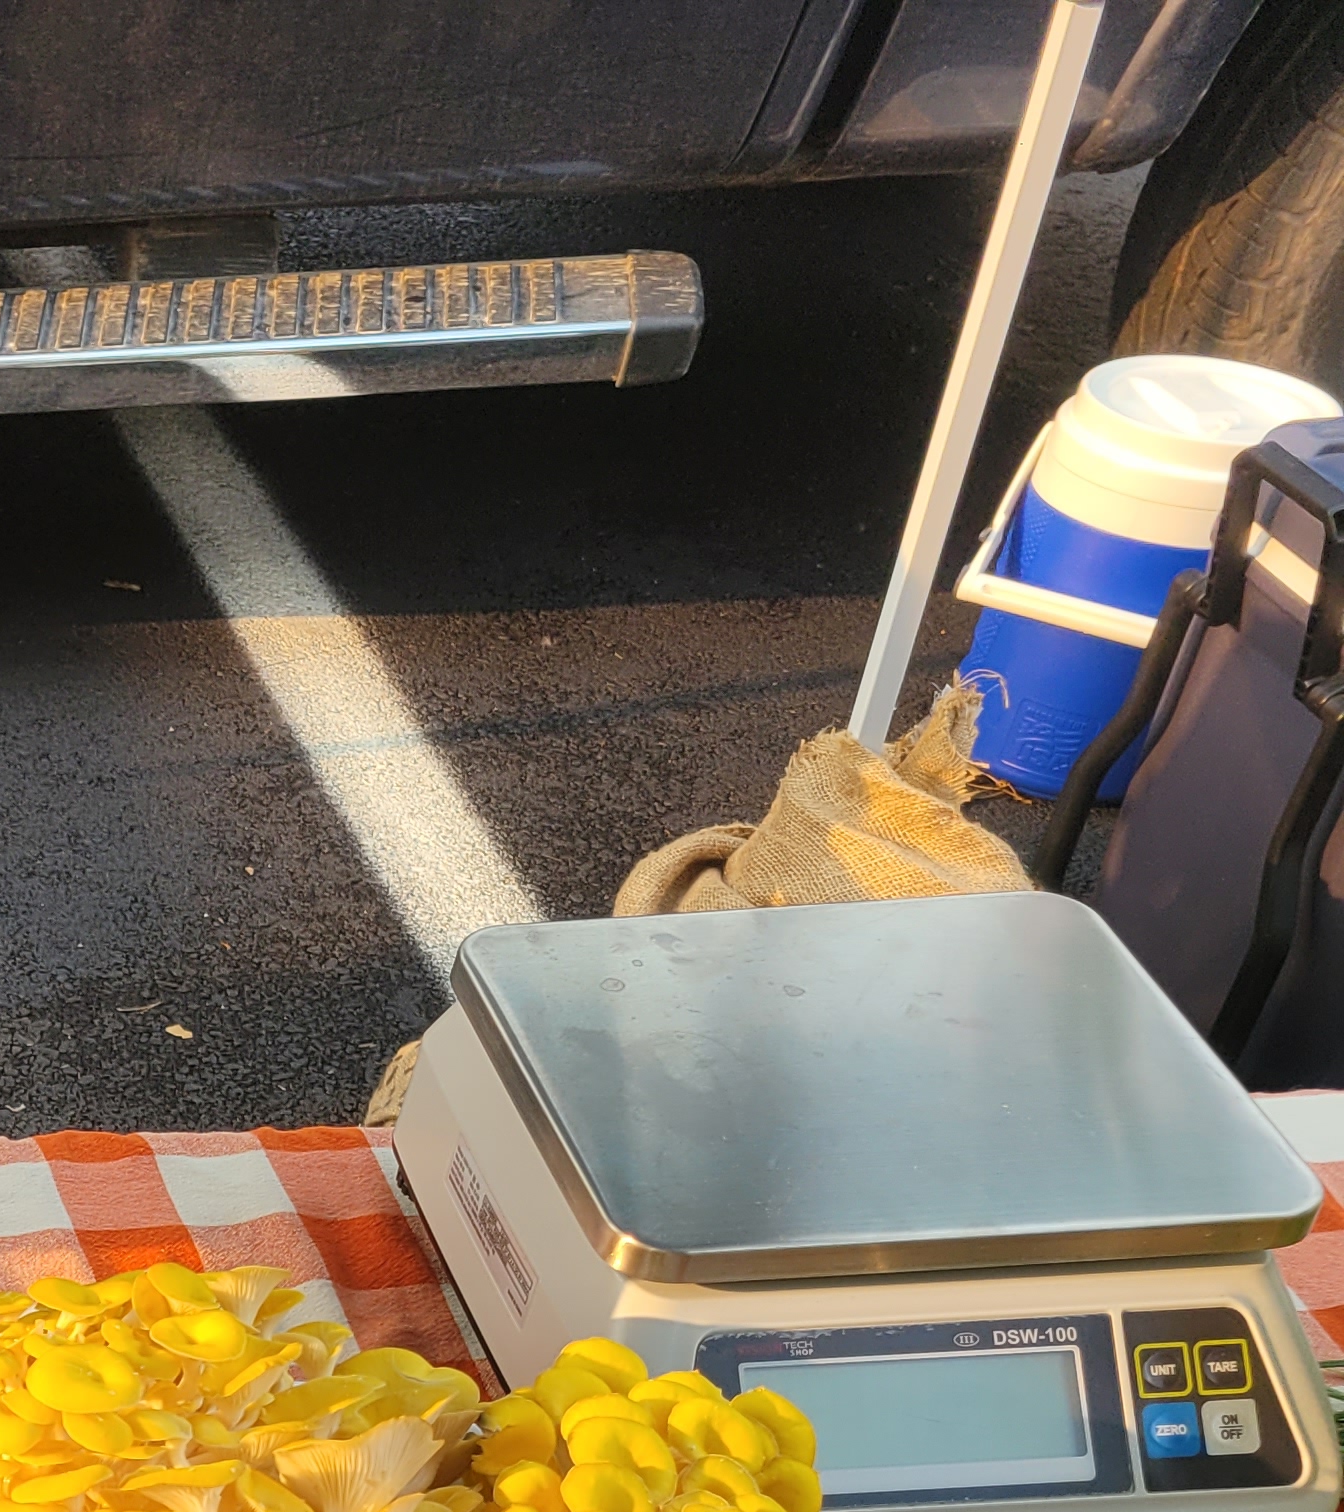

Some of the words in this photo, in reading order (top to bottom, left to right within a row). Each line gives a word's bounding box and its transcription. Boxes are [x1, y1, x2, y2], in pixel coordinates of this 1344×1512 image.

[959, 1335, 974, 1344] III
[992, 1326, 1078, 1346] DSW-100
[782, 1340, 814, 1350] TECH
[789, 1348, 814, 1357] SHOP
[1150, 1364, 1176, 1376] UNIT
[1207, 1361, 1238, 1373] TARE
[1221, 1414, 1239, 1425] ON
[1155, 1424, 1188, 1437] ZERO
[1220, 1429, 1244, 1440] OFF
